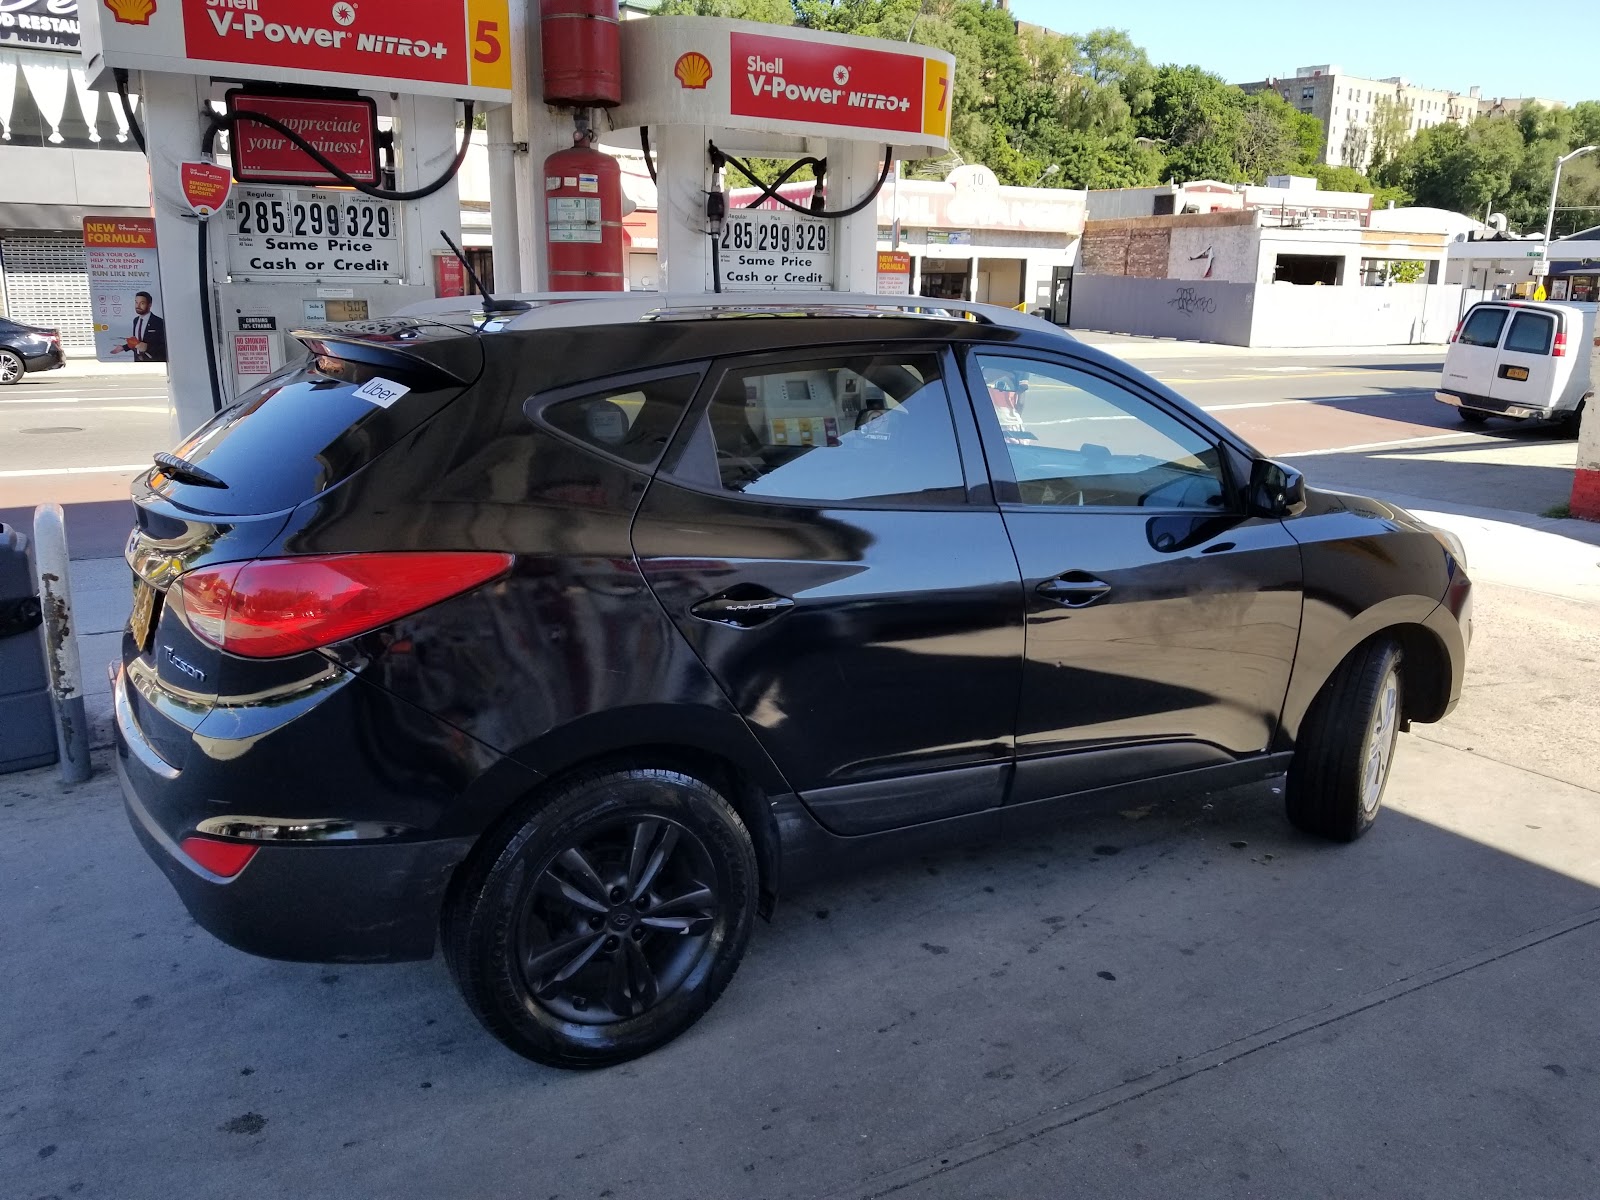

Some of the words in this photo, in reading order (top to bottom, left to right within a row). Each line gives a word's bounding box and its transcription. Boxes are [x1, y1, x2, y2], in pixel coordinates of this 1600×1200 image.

[207, 8, 346, 48] V-Power
[474, 20, 501, 63] 5
[747, 55, 783, 74] Shell
[747, 73, 842, 104] V-Power
[938, 77, 949, 111] 7
[247, 137, 286, 152] your
[972, 173, 984, 186] 10
[246, 191, 276, 199] Regular
[238, 201, 285, 234] 285
[293, 203, 340, 236] 299
[347, 205, 390, 238] 329
[87, 223, 115, 233] NEW
[721, 222, 753, 249] 285
[796, 224, 826, 251] 329
[87, 233, 146, 244] FORMULA
[266, 238, 319, 250] Same
[328, 239, 373, 252] Price
[759, 224, 790, 252] 299
[250, 258, 296, 270] Cash
[305, 262, 325, 270] or
[334, 259, 389, 271] Credit
[739, 255, 775, 266] Same
[781, 256, 812, 267] Price
[879, 262, 906, 270] FORMULA
[727, 271, 758, 282] Cash
[784, 273, 823, 282] Credit
[362, 381, 397, 401] Uber
